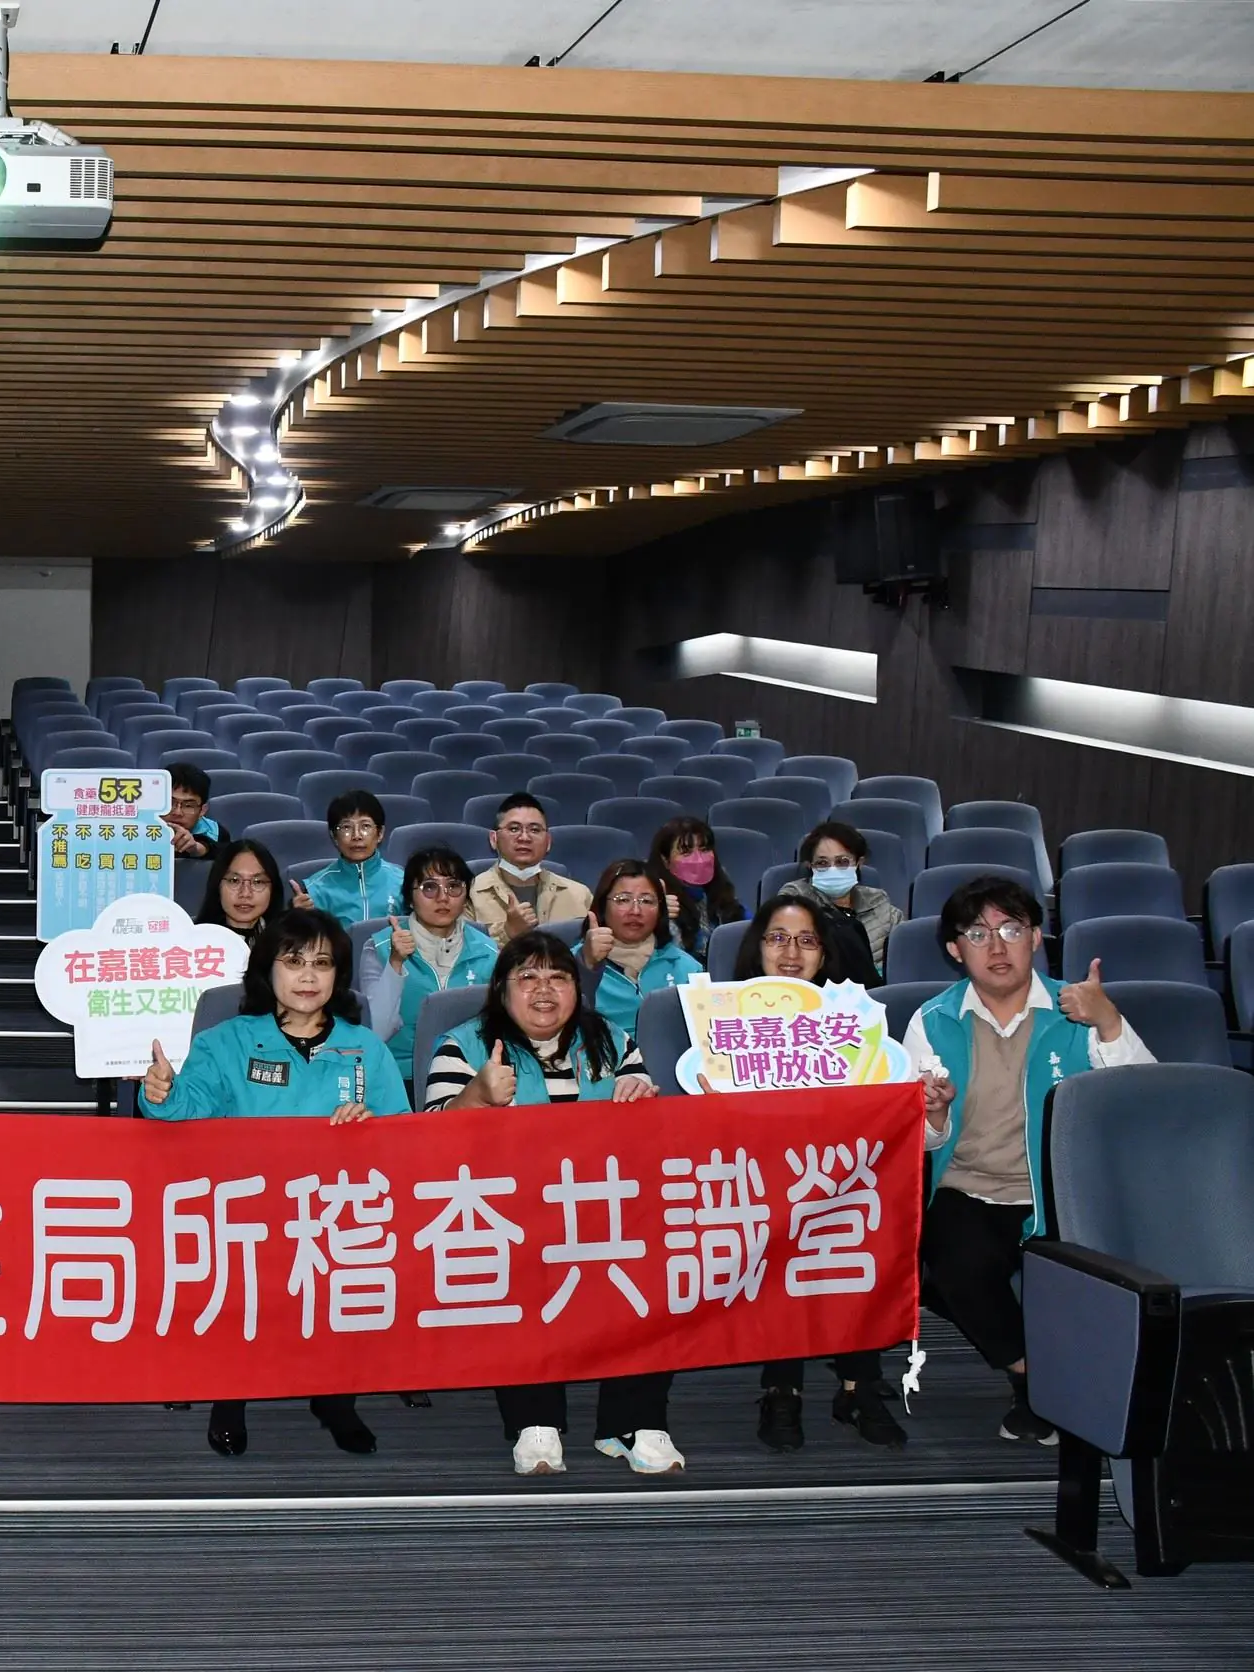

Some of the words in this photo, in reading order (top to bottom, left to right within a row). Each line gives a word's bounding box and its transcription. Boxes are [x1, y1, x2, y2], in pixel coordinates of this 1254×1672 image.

[64, 945, 226, 984] 在嘉護食安
[713, 1013, 863, 1052] 最嘉食安
[735, 1050, 848, 1084] 呷放心
